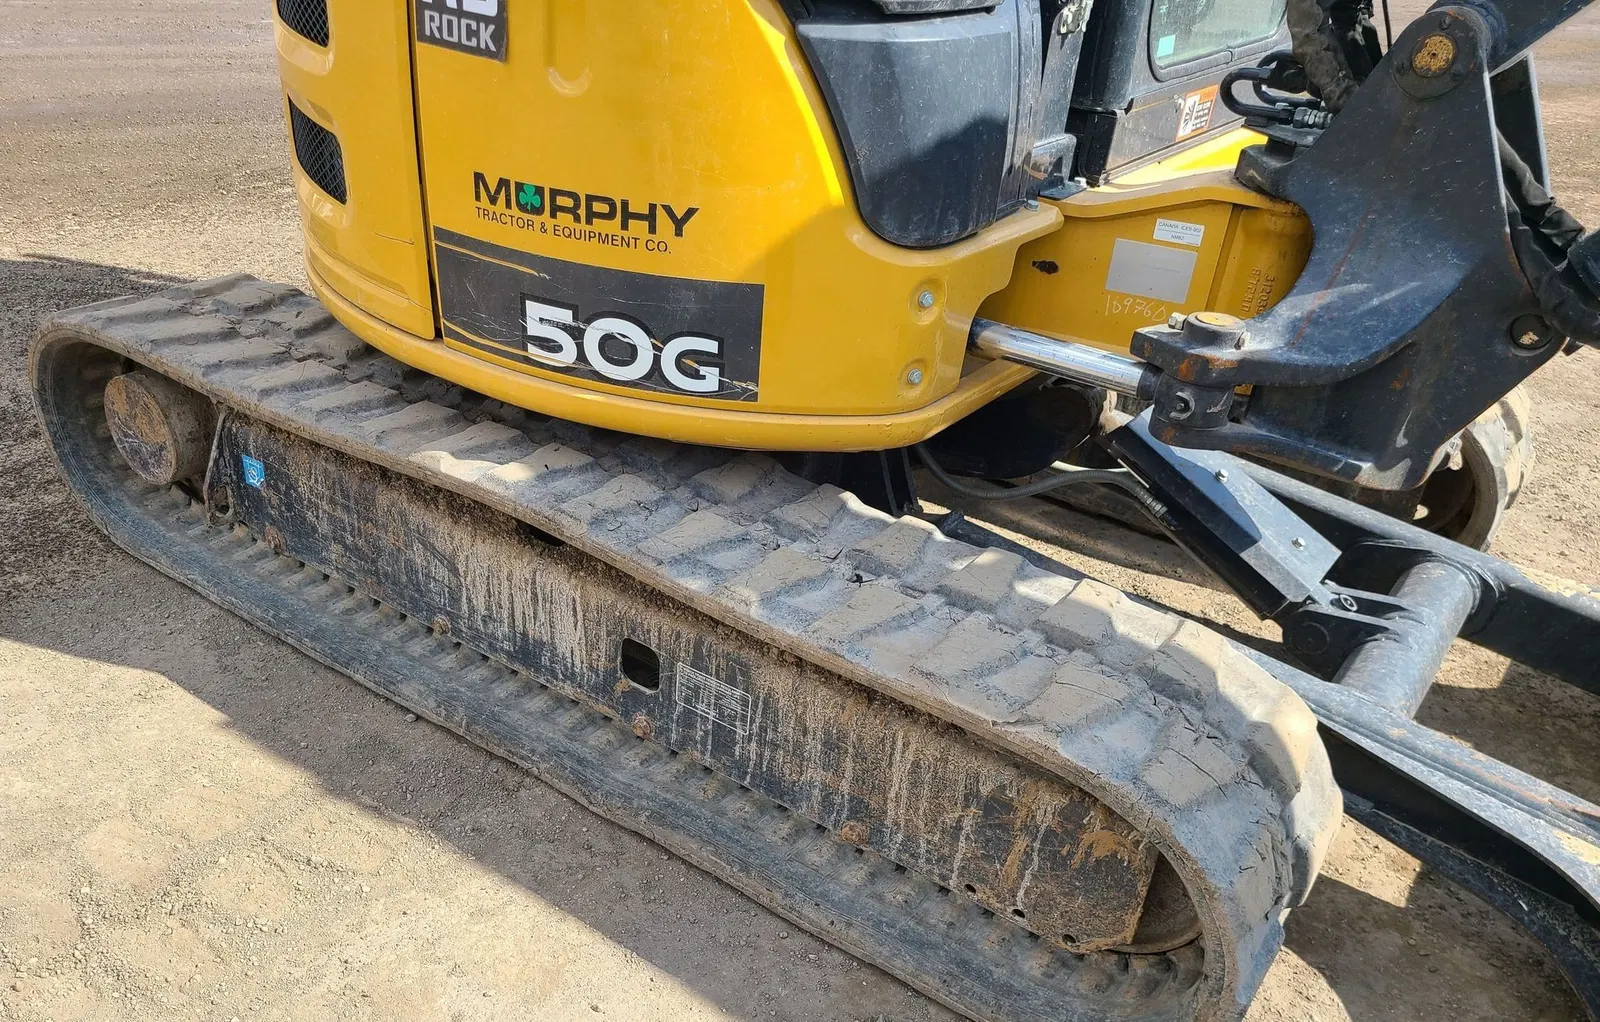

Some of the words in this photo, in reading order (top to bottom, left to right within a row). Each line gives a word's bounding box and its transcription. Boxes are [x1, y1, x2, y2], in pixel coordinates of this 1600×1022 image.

[424, 9, 497, 52] ROCK
[473, 171, 700, 238] MURPHY
[1158, 221, 1179, 230] CANADA
[475, 206, 535, 232] TRACTOR
[539, 223, 548, 234] &
[553, 224, 640, 250] EQUIPMENT
[645, 239, 672, 254] CO.
[525, 300, 720, 393] 50G
